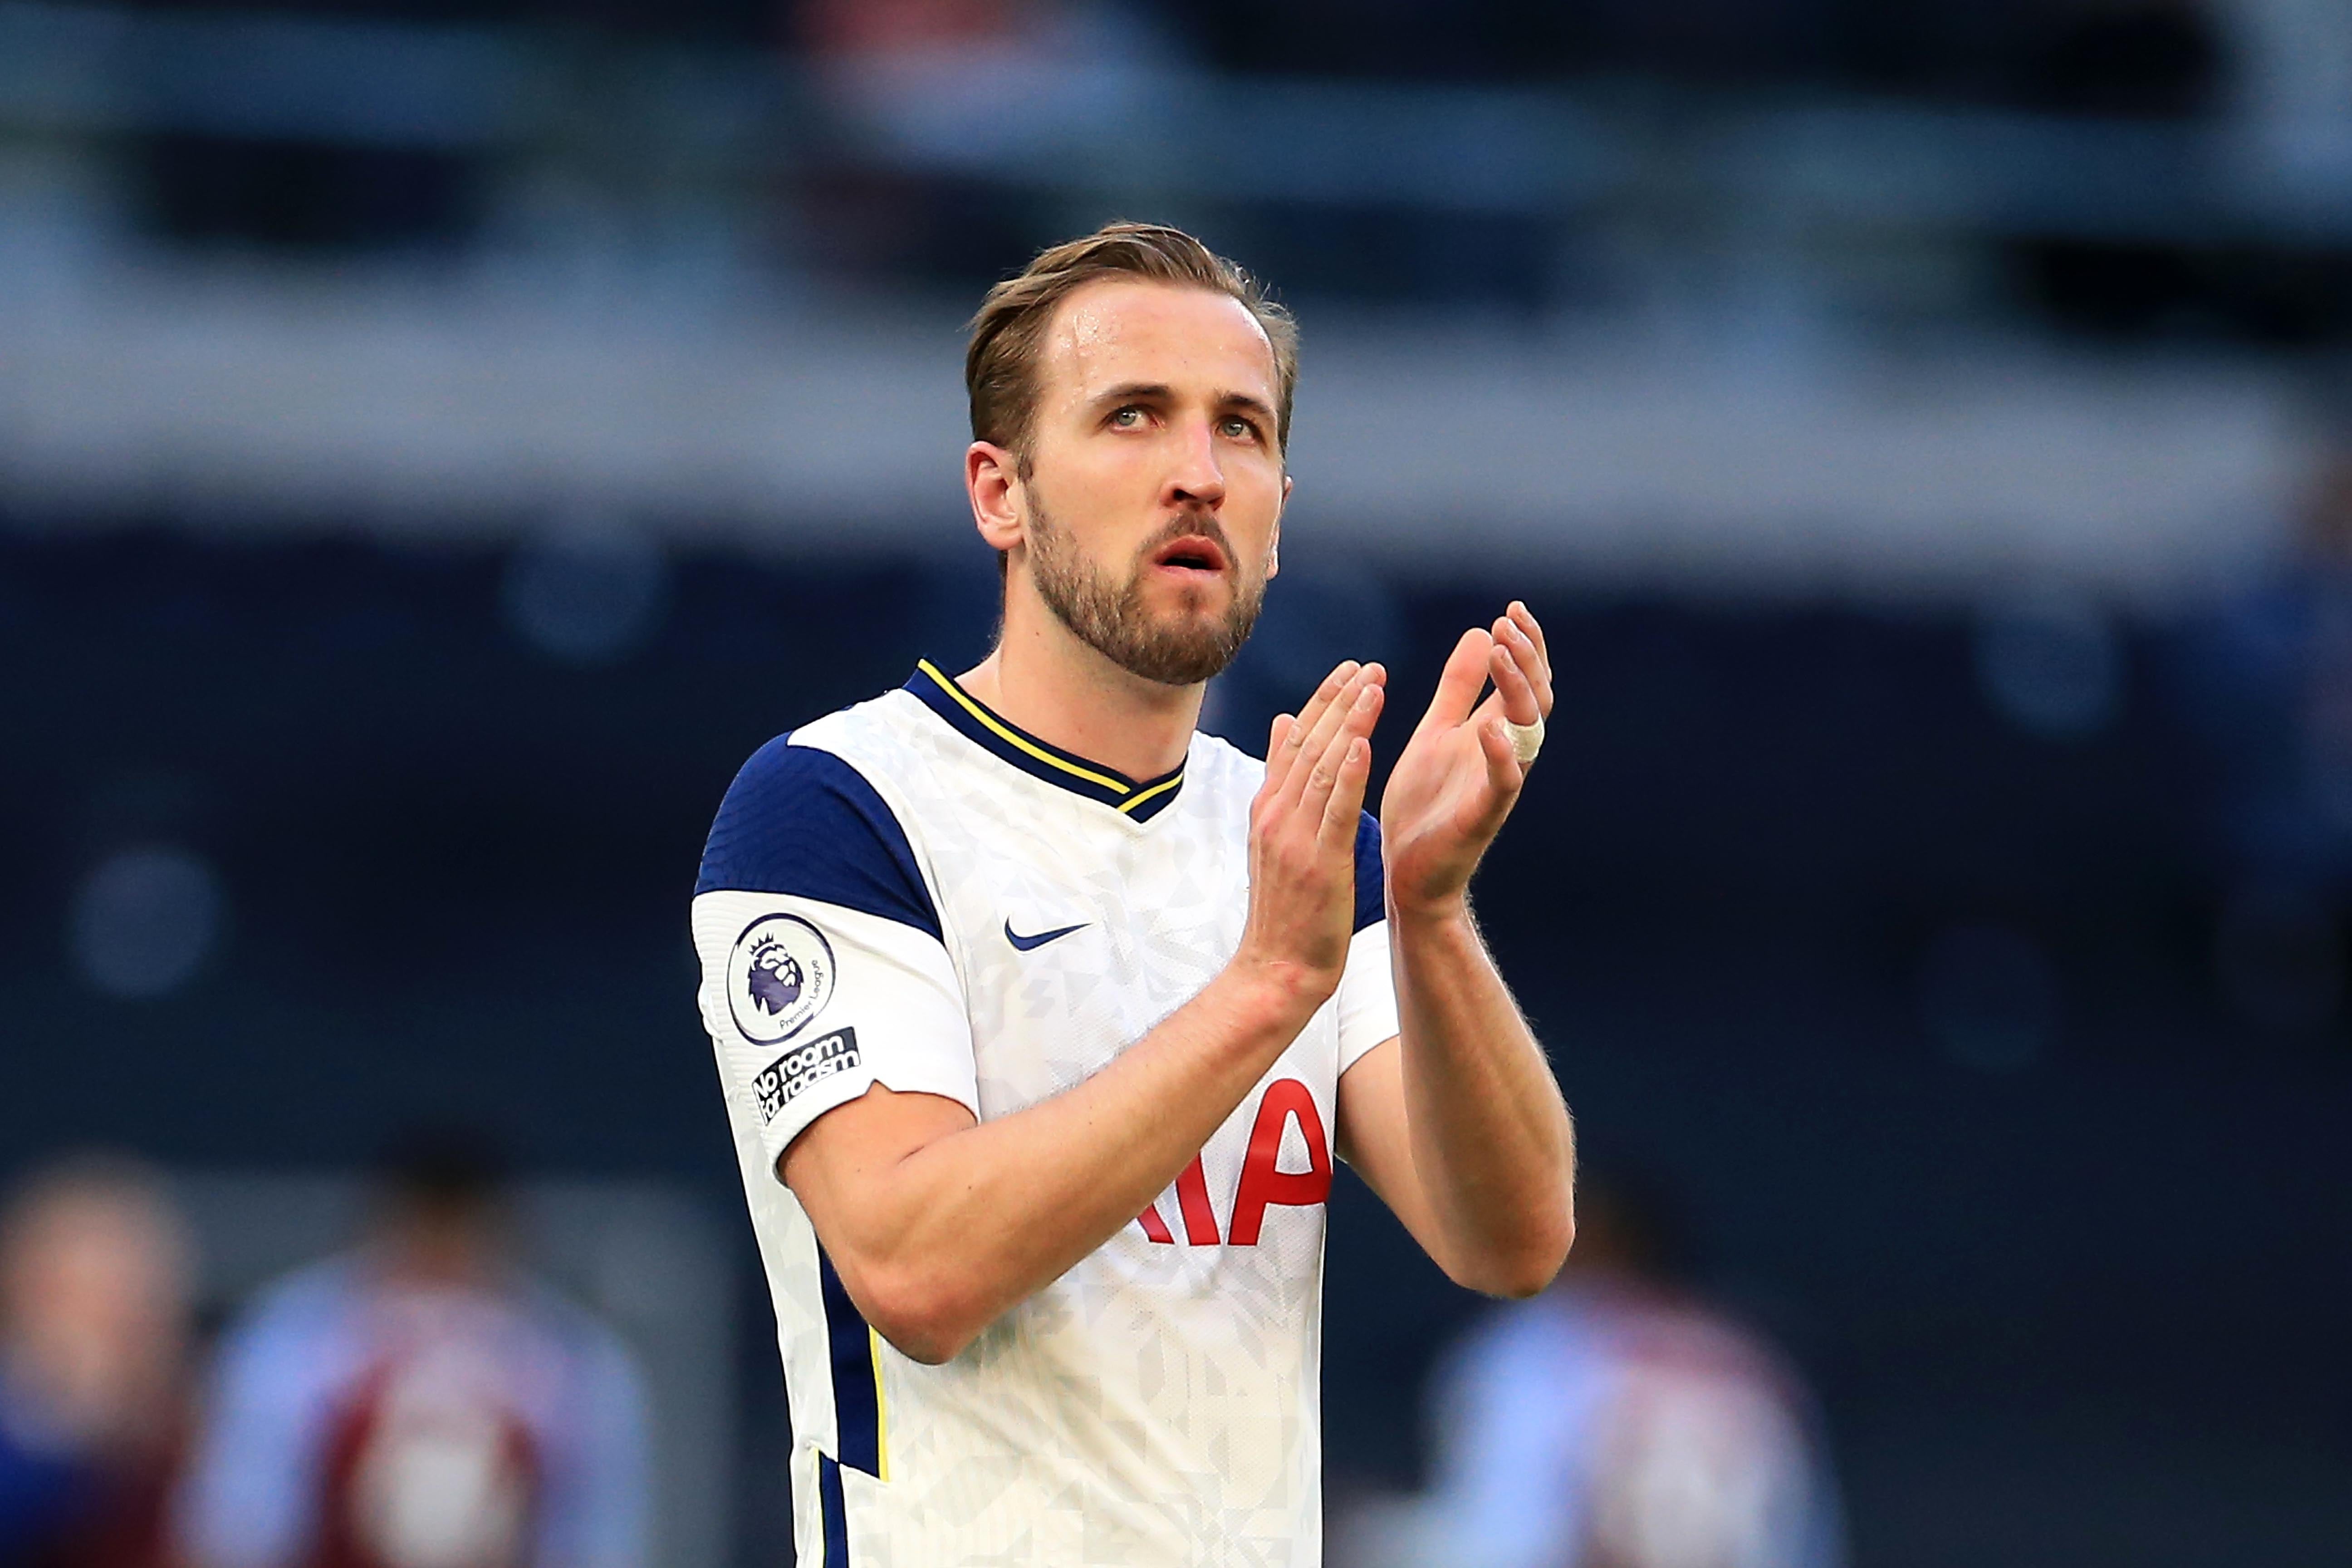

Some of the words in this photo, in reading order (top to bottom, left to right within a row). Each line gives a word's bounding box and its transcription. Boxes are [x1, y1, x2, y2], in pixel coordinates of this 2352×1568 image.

[780, 1001, 813, 1029] Premier
[808, 960, 824, 999] League
[753, 1071, 778, 1102] No
[779, 1035, 844, 1083] room
[760, 1089, 780, 1126] for
[782, 1050, 860, 1102] racism
